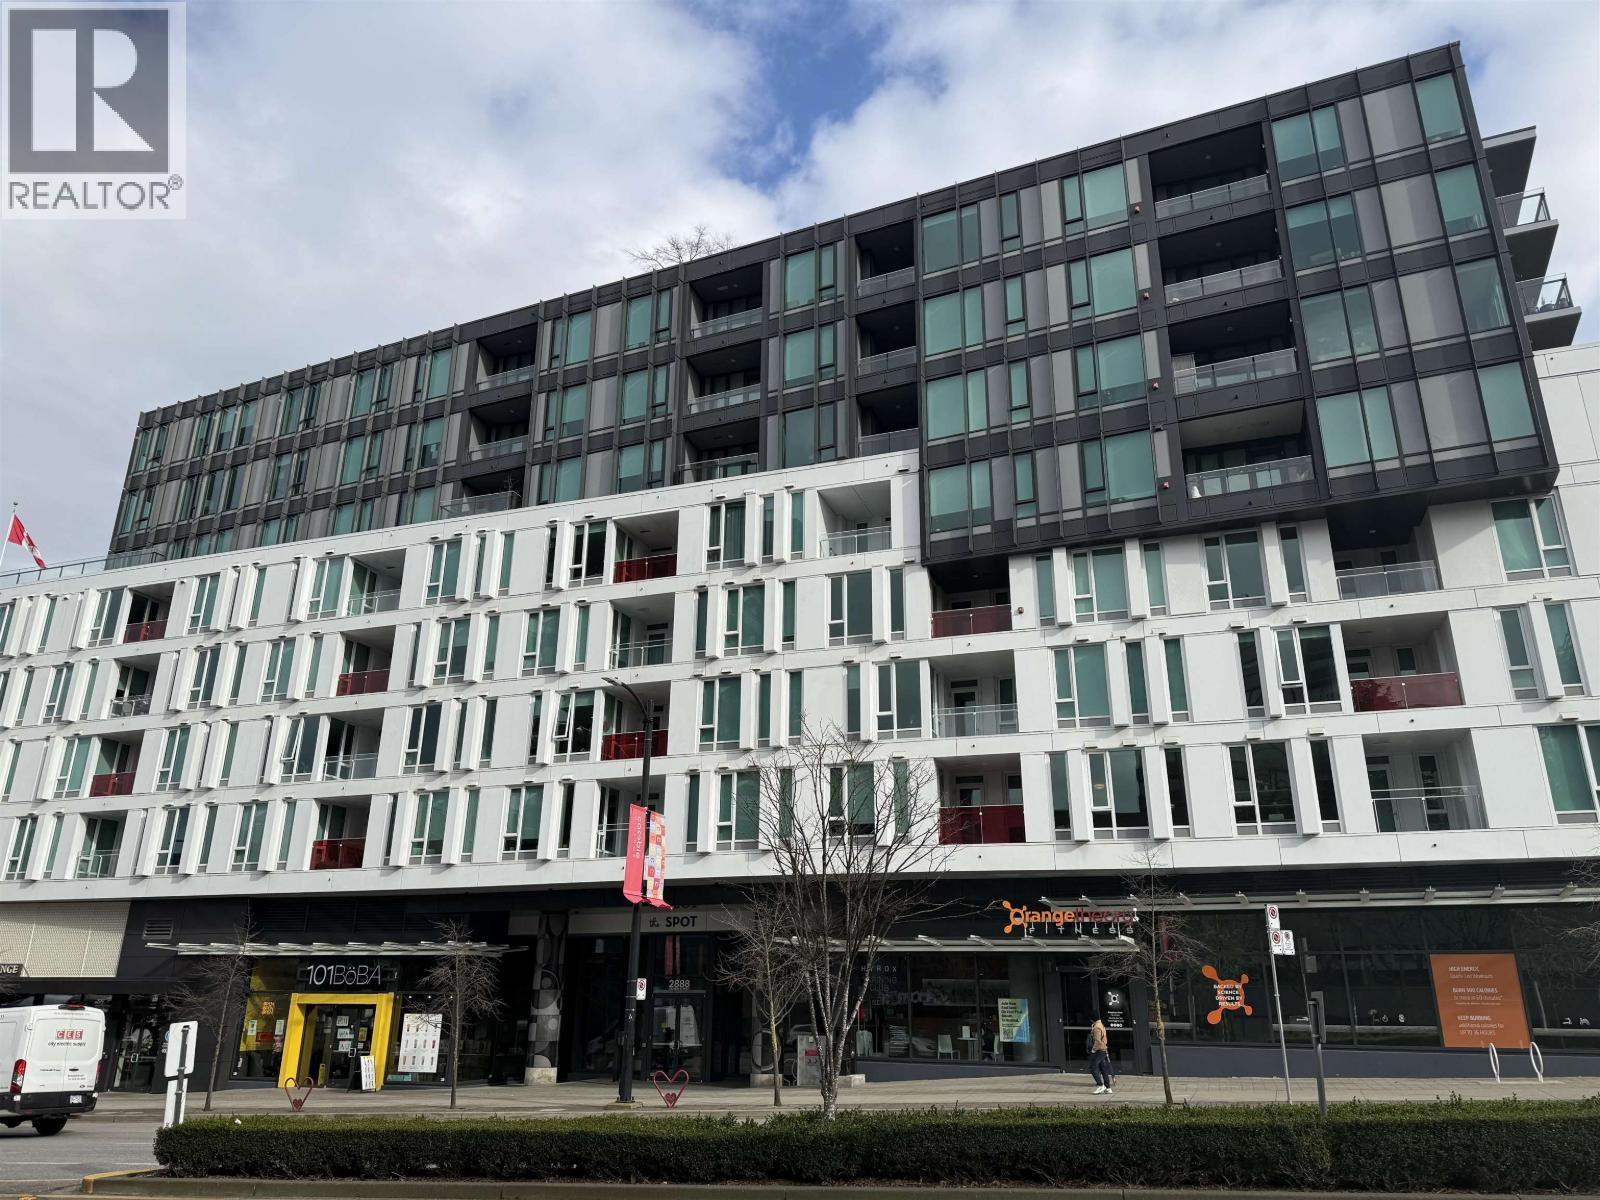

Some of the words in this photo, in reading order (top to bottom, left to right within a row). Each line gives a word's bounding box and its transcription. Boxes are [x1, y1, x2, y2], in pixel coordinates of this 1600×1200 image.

[665, 915, 698, 928] SPOT
[669, 979, 691, 988] 2888
[57, 1030, 82, 1039] CES
